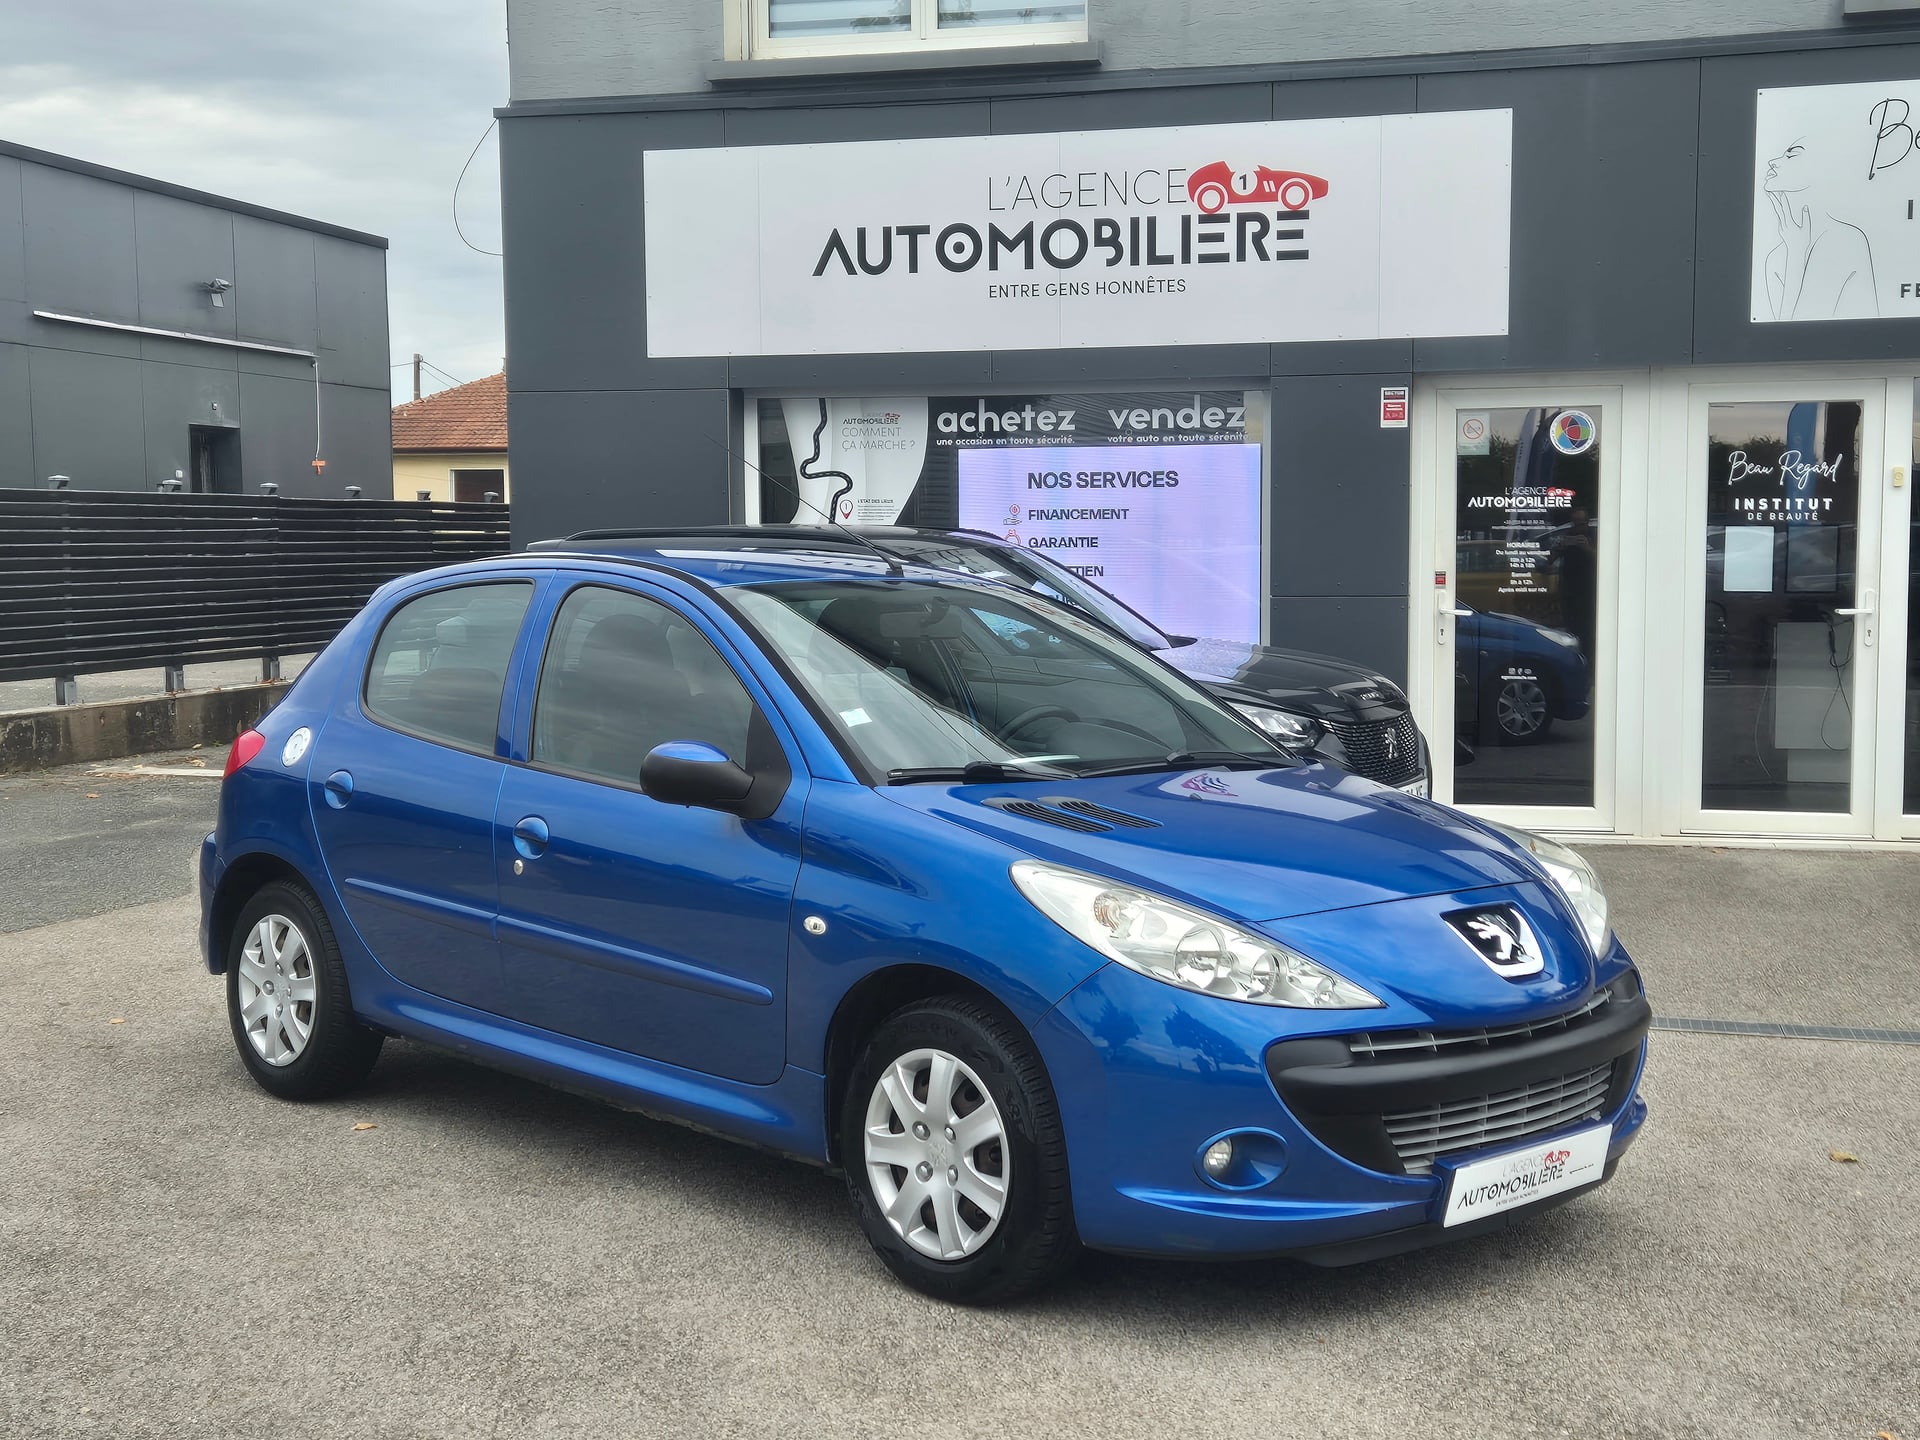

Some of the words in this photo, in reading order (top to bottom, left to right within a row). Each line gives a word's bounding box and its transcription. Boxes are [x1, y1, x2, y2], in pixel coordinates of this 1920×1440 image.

[1238, 174, 1249, 190] 1
[988, 168, 1187, 211] L'AGENCE
[812, 209, 1310, 277] AUTOMOBILIERE
[988, 283, 1040, 298] ENTRE
[1045, 281, 1090, 297] GENS
[1095, 276, 1186, 295] HONNÊTES
[937, 399, 1076, 432] achetez
[1107, 395, 1247, 429] vendez
[842, 427, 901, 437] COMMENT
[936, 438, 953, 446] une
[955, 436, 993, 446] occasion
[996, 438, 1007, 446] en
[1010, 437, 1034, 445] toute
[1037, 434, 1075, 445] sécurité.
[1107, 435, 1133, 443] votre
[1136, 434, 1160, 443] auto
[1178, 434, 1205, 442] toute
[842, 440, 856, 452] ÇA
[860, 440, 906, 450] MARCHE
[910, 440, 916, 449] ?
[1728, 451, 1774, 486] Beau
[1778, 450, 1843, 489] Regard
[1027, 472, 1072, 489] NOS
[1076, 470, 1179, 488] SERVICES
[1505, 487, 1547, 495] L'AGENCE
[1467, 496, 1572, 508] AUTOMOBILIERE
[1735, 498, 1833, 510] INSTITUT
[1028, 509, 1129, 520] FINANCEMENT
[1770, 510, 1818, 521] BEAUTÉ
[1028, 537, 1098, 548] GARANTIE
